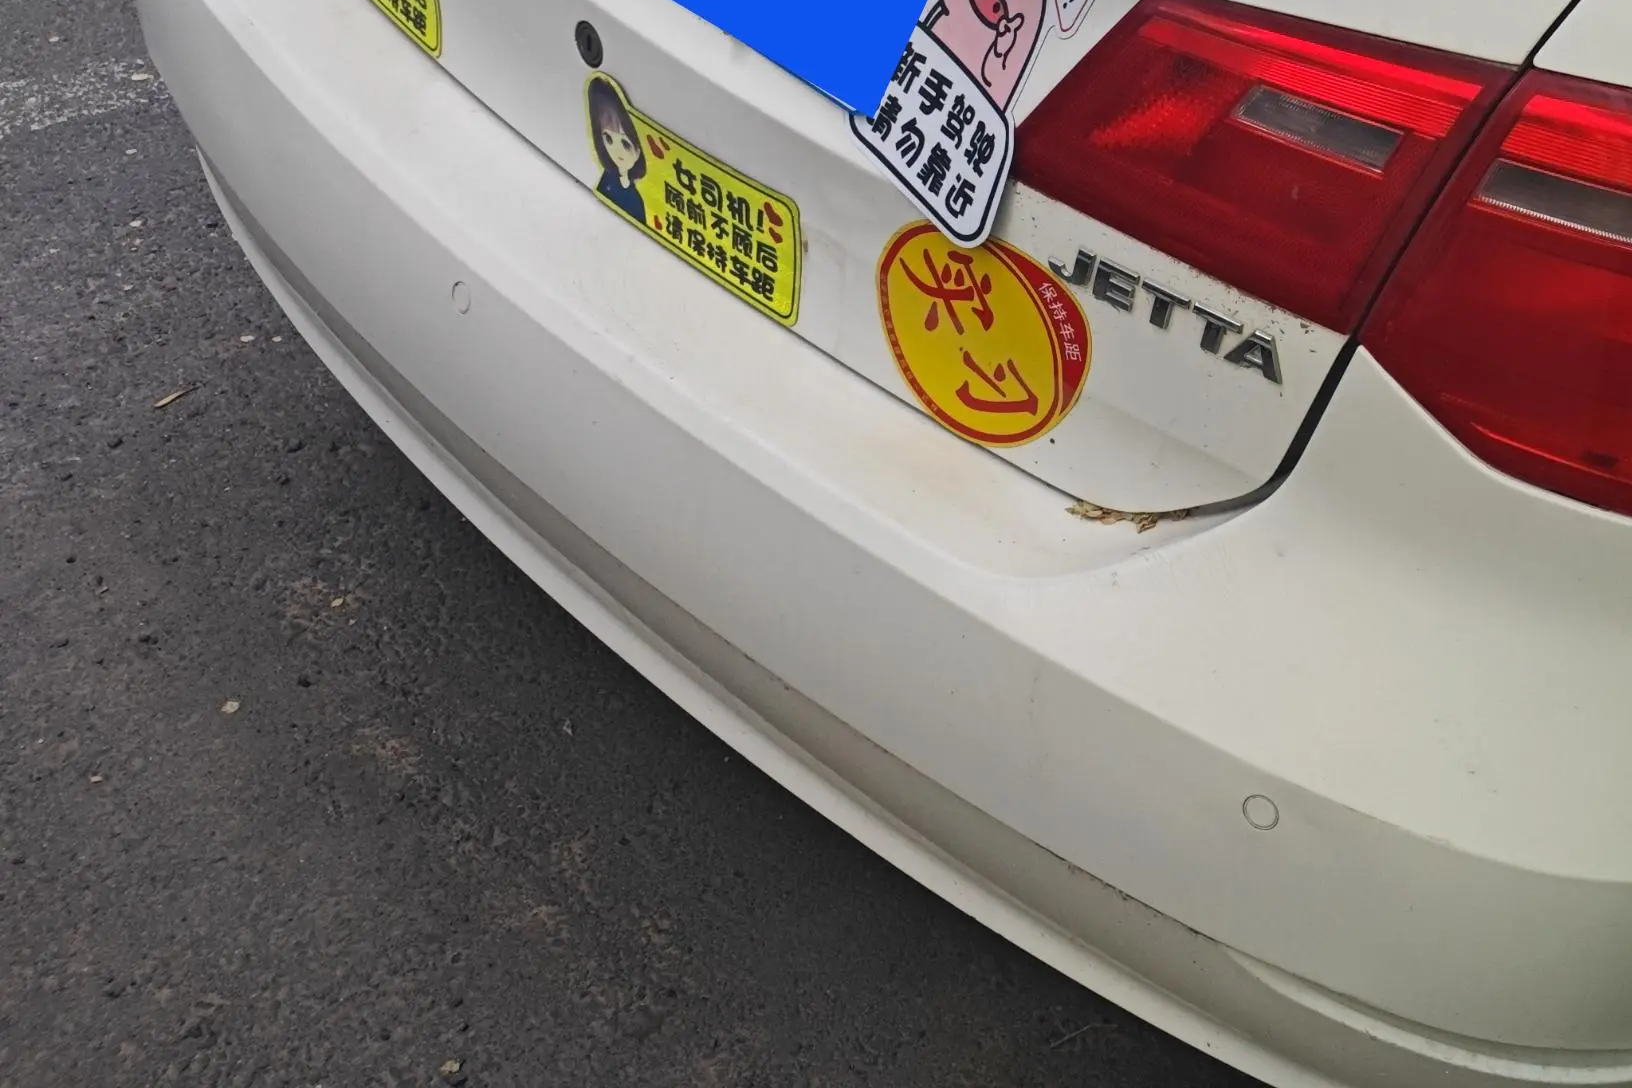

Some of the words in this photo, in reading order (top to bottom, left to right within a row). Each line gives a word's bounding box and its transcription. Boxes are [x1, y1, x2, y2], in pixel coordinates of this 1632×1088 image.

[867, 94, 977, 219] 请勿靠近
[890, 41, 996, 178] 新手驾驶
[664, 180, 778, 274] 顾前不顾后
[665, 212, 776, 302] 请保持车距
[899, 247, 1039, 417] 实习
[1038, 282, 1082, 363] 保持车距
[1048, 247, 1283, 385] JETTA
